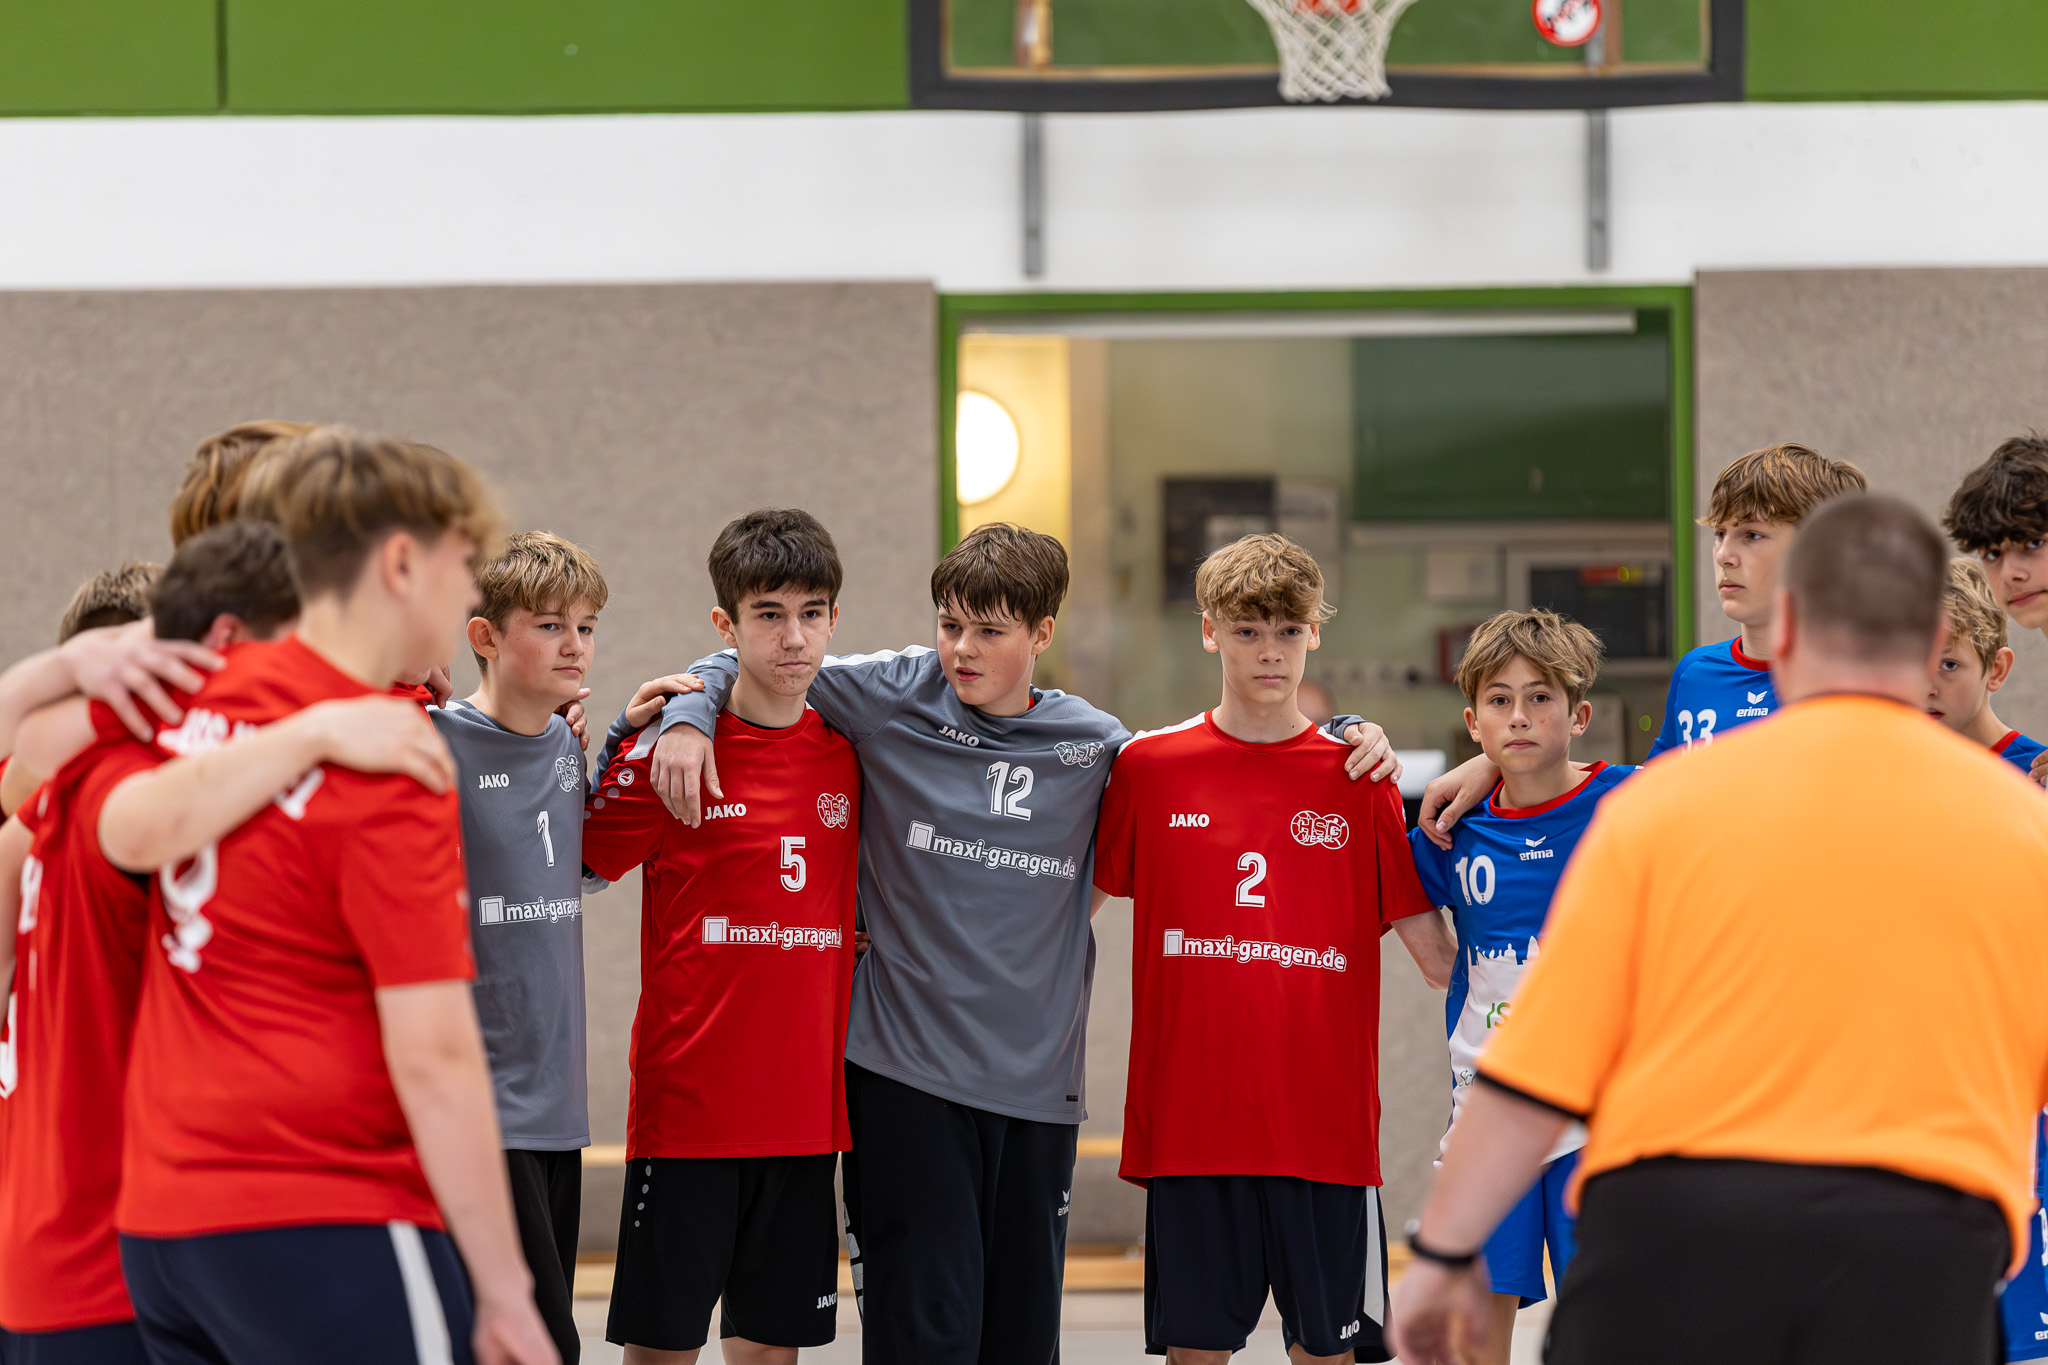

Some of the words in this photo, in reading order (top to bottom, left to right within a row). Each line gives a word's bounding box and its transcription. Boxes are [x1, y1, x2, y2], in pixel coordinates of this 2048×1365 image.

[1736, 706, 1769, 717] erima
[938, 725, 980, 747] JAKO
[1678, 708, 1717, 754] 33
[478, 773, 510, 789] JAKO
[986, 761, 1034, 821] 12
[704, 803, 747, 820] JAKO
[1168, 813, 1210, 828] JAKO
[1298, 817, 1342, 839] HSG
[536, 810, 555, 867] 1
[1519, 849, 1554, 861] erima
[780, 836, 807, 893] 5
[932, 839, 1076, 880] maxi-garagen.de
[1235, 851, 1267, 908] 2
[1455, 854, 1496, 906] 10
[1184, 936, 1347, 971] maxi-garagen.de
